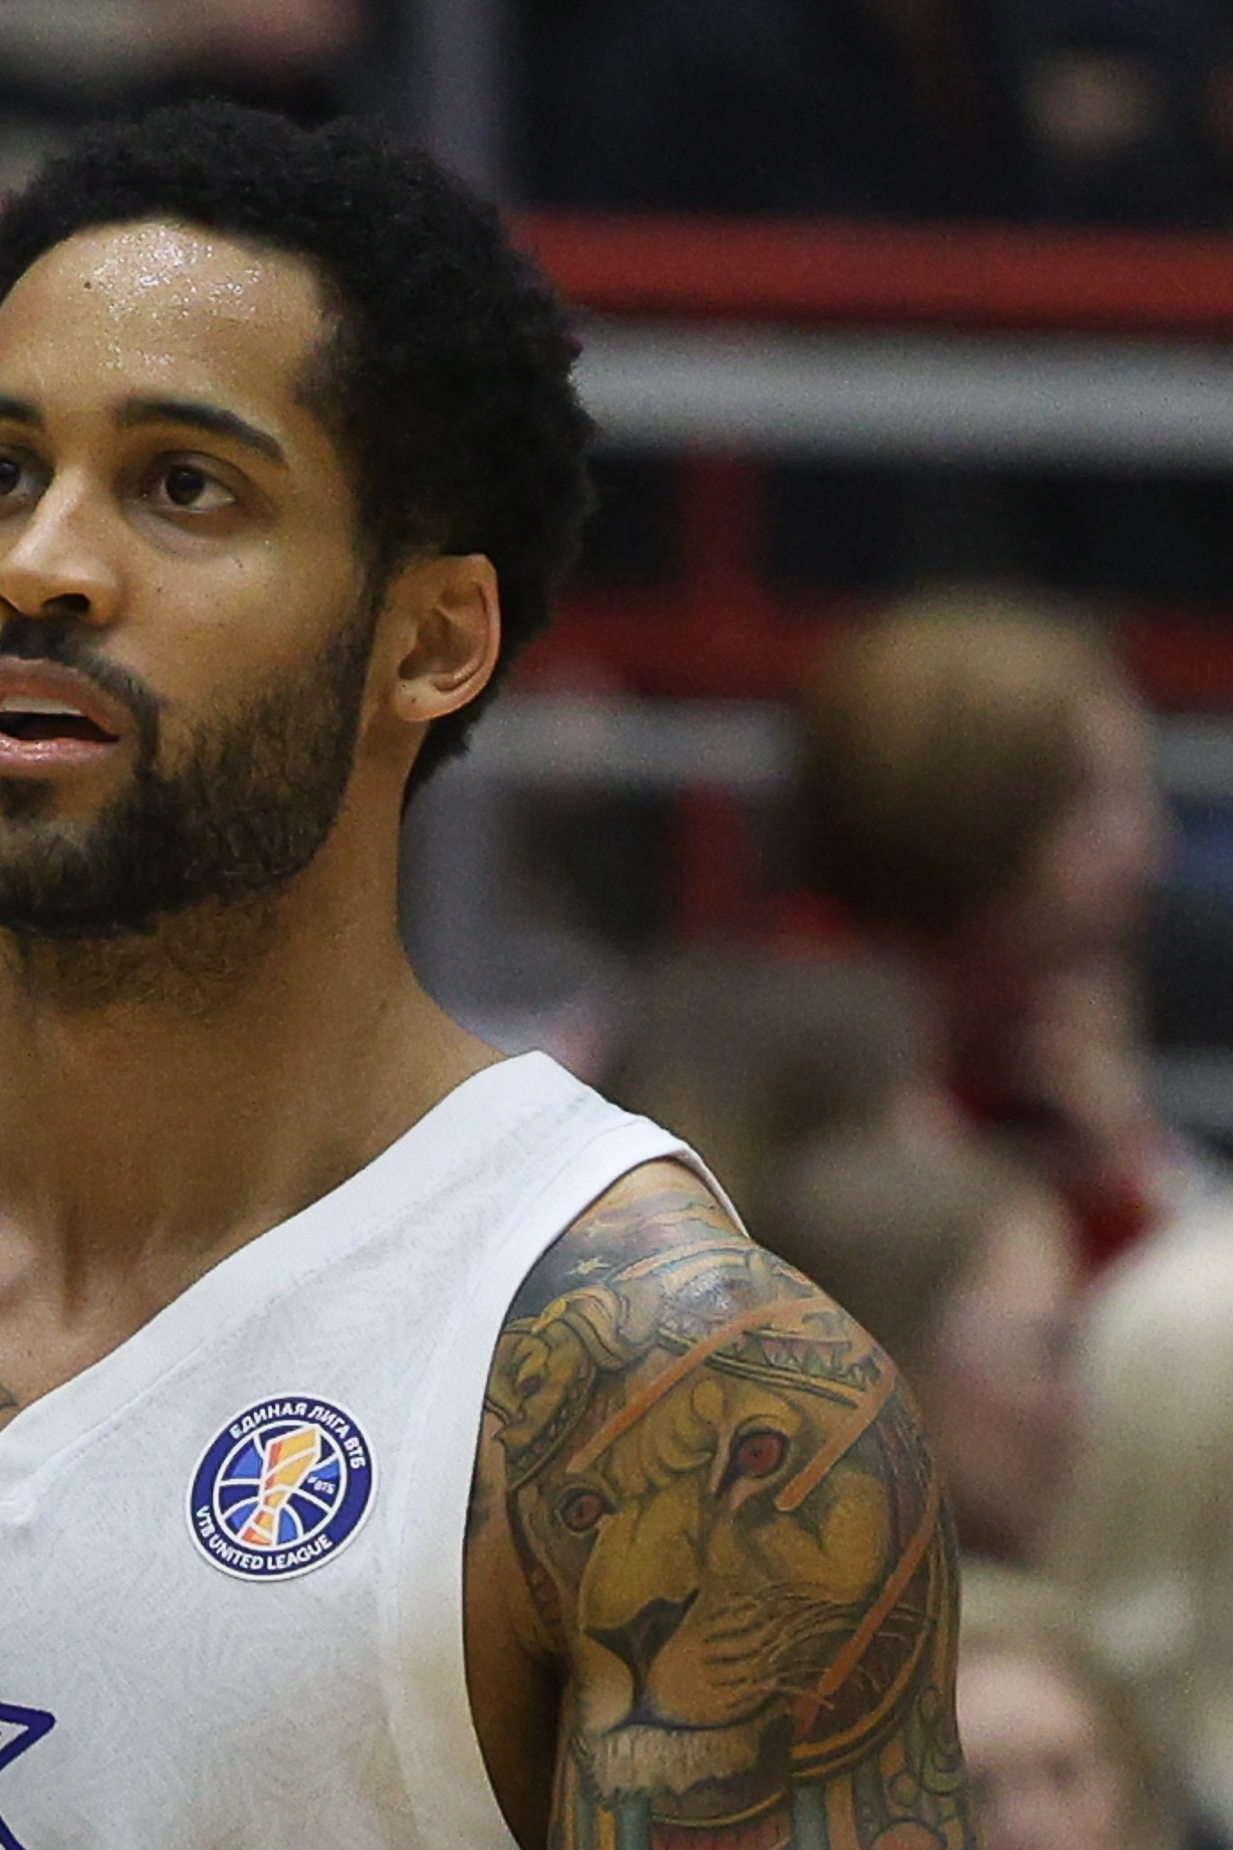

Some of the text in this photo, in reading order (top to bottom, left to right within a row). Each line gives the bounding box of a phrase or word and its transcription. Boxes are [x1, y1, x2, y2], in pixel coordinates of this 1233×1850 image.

[229, 1402, 366, 1469] ЕДИНАЯ ЛИГА ВТБ
[196, 1505, 333, 1570] VTB UNITED LEAGUE
